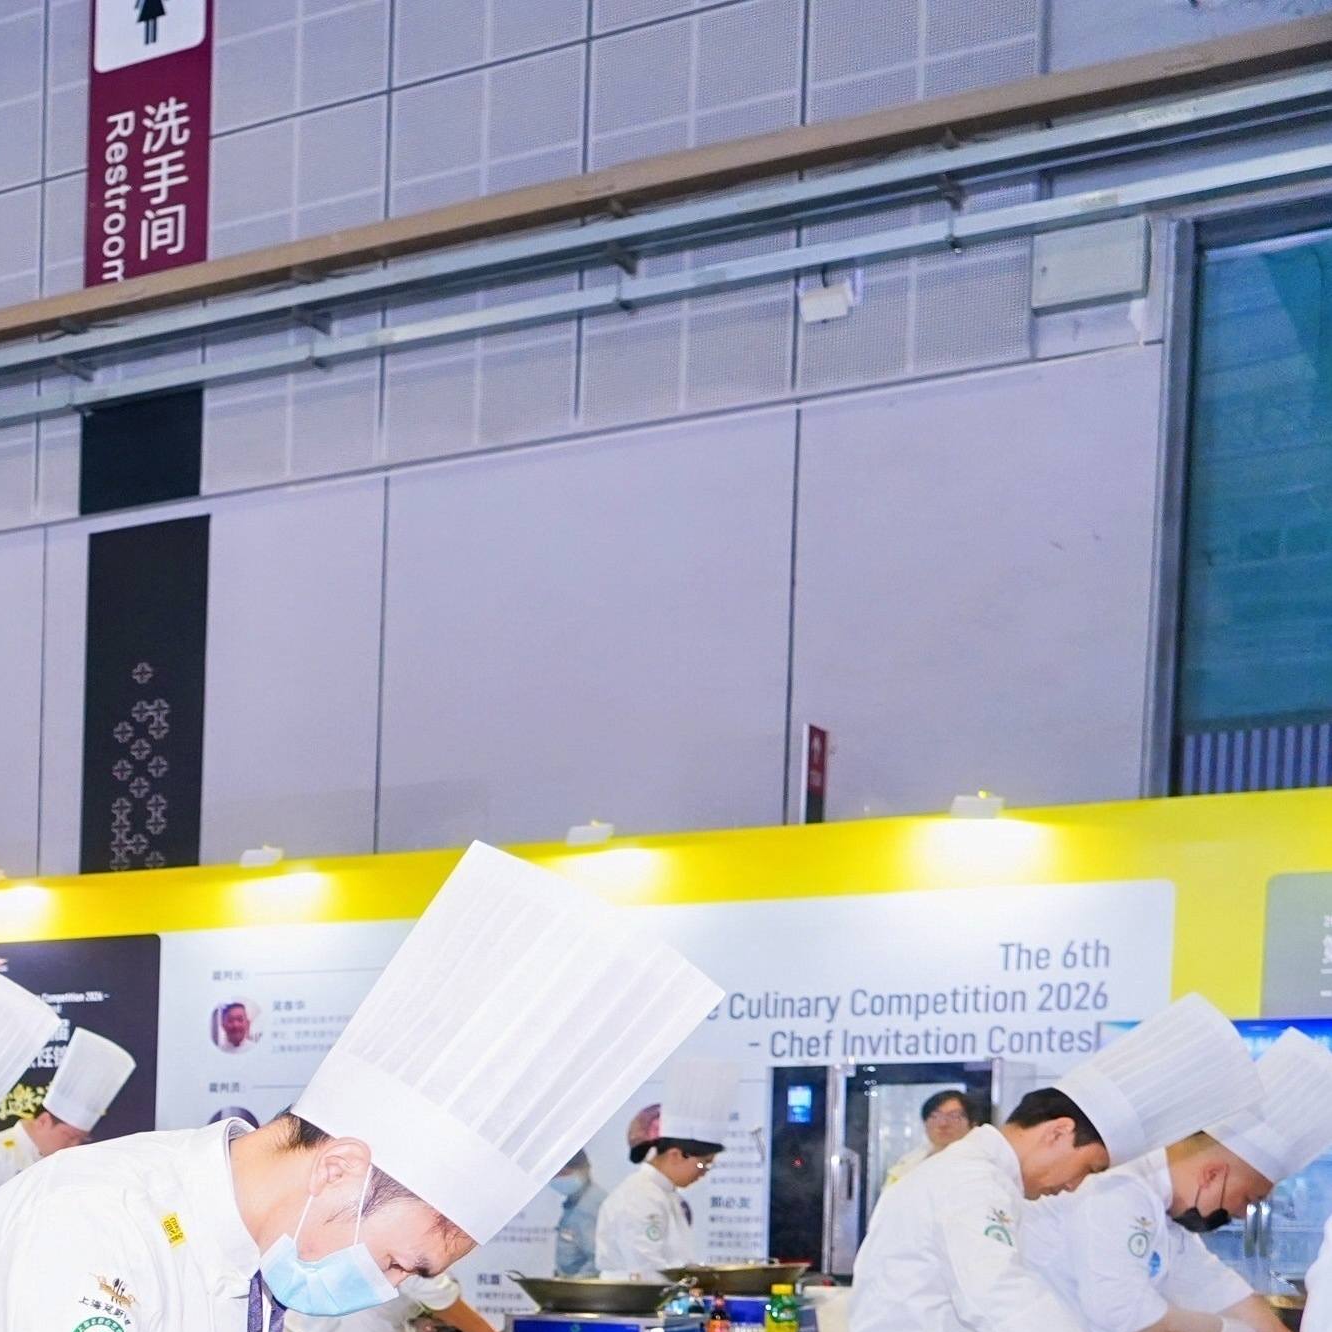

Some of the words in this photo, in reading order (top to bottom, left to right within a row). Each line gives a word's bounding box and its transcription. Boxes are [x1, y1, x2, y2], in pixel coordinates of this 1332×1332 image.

[140, 97, 190, 260] 洗手间
[999, 943, 1051, 971] The
[1063, 940, 1110, 969] 6th
[729, 991, 840, 1023] Culinary
[851, 985, 1027, 1021] Competition
[1038, 982, 1108, 1011] 2026
[769, 1030, 835, 1058] Chef
[843, 1027, 976, 1057] Invitation
